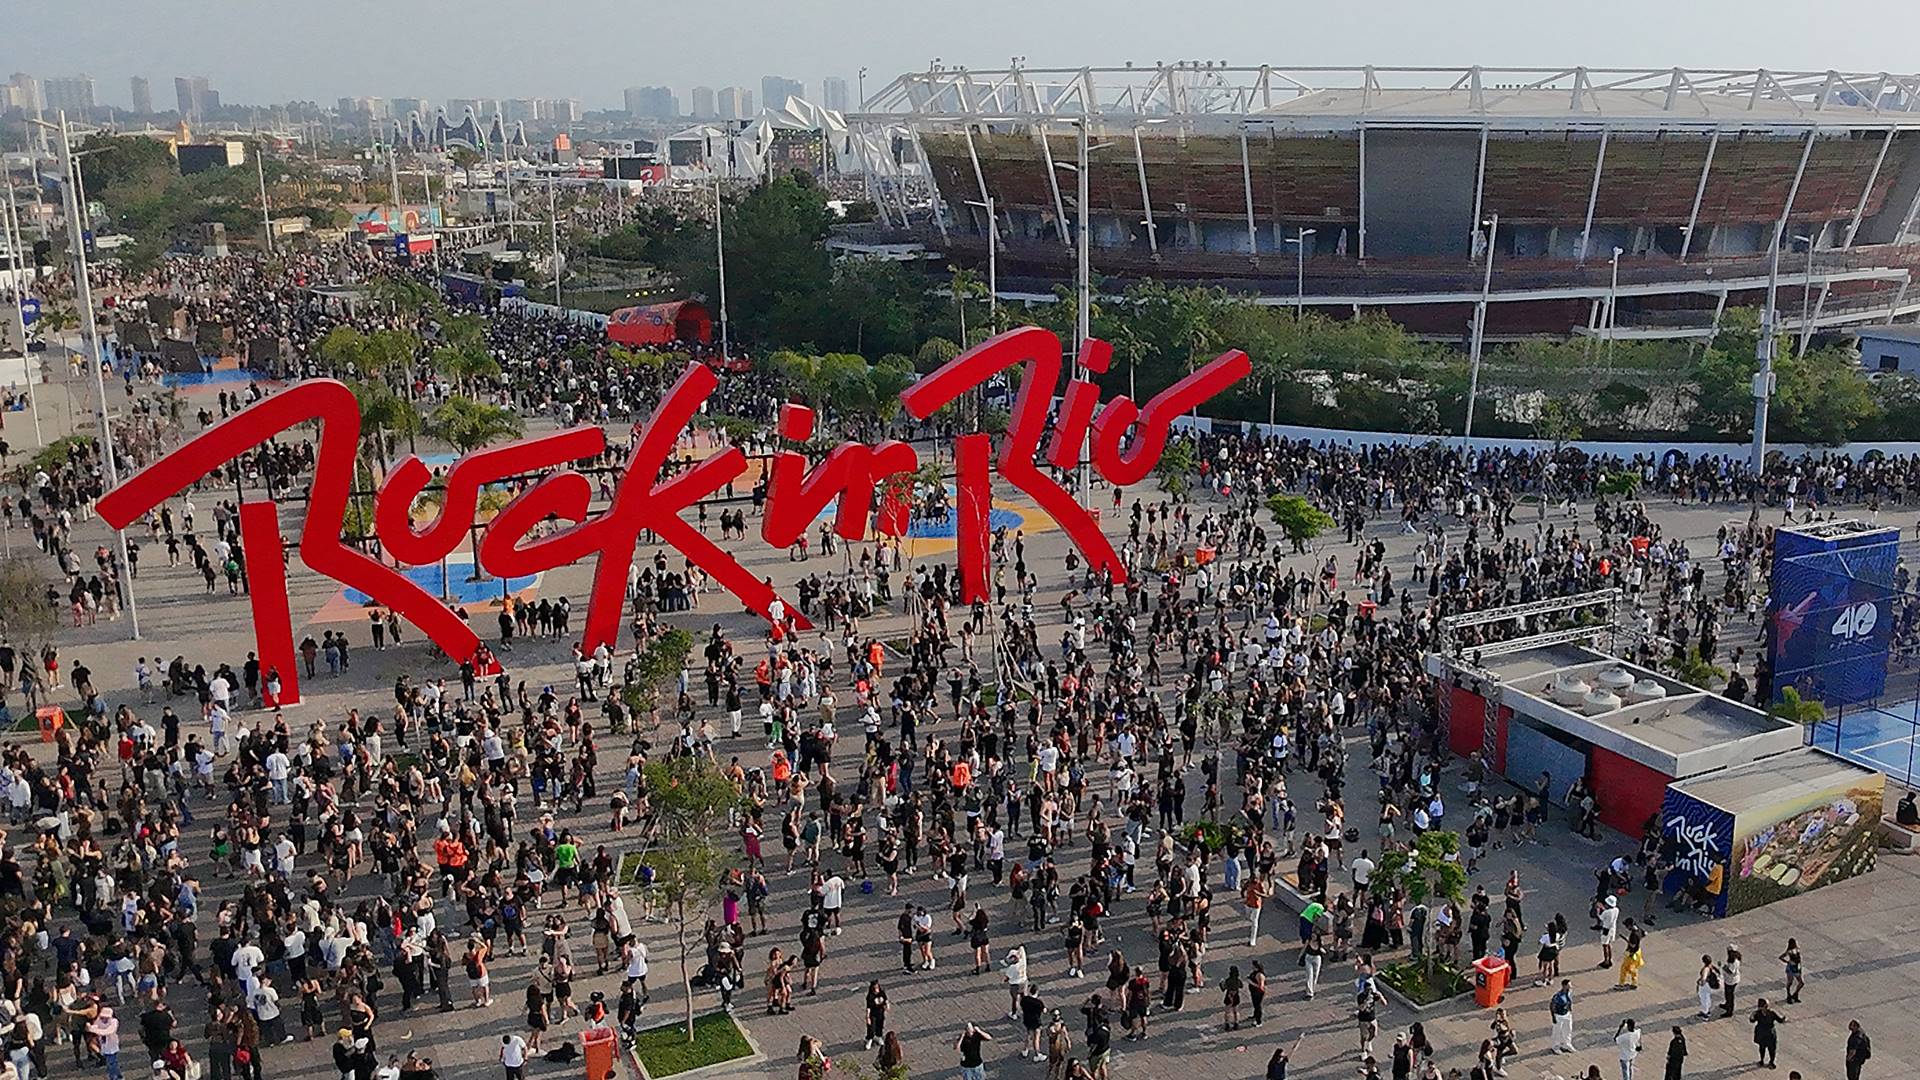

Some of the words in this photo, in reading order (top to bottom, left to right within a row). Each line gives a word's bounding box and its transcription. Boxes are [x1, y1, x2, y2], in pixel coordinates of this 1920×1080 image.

[95, 361, 815, 708] Rock
[761, 403, 918, 550] in
[900, 325, 1253, 606] Rio
[1666, 815, 1719, 852] Rock
[1675, 851, 1690, 871] in
